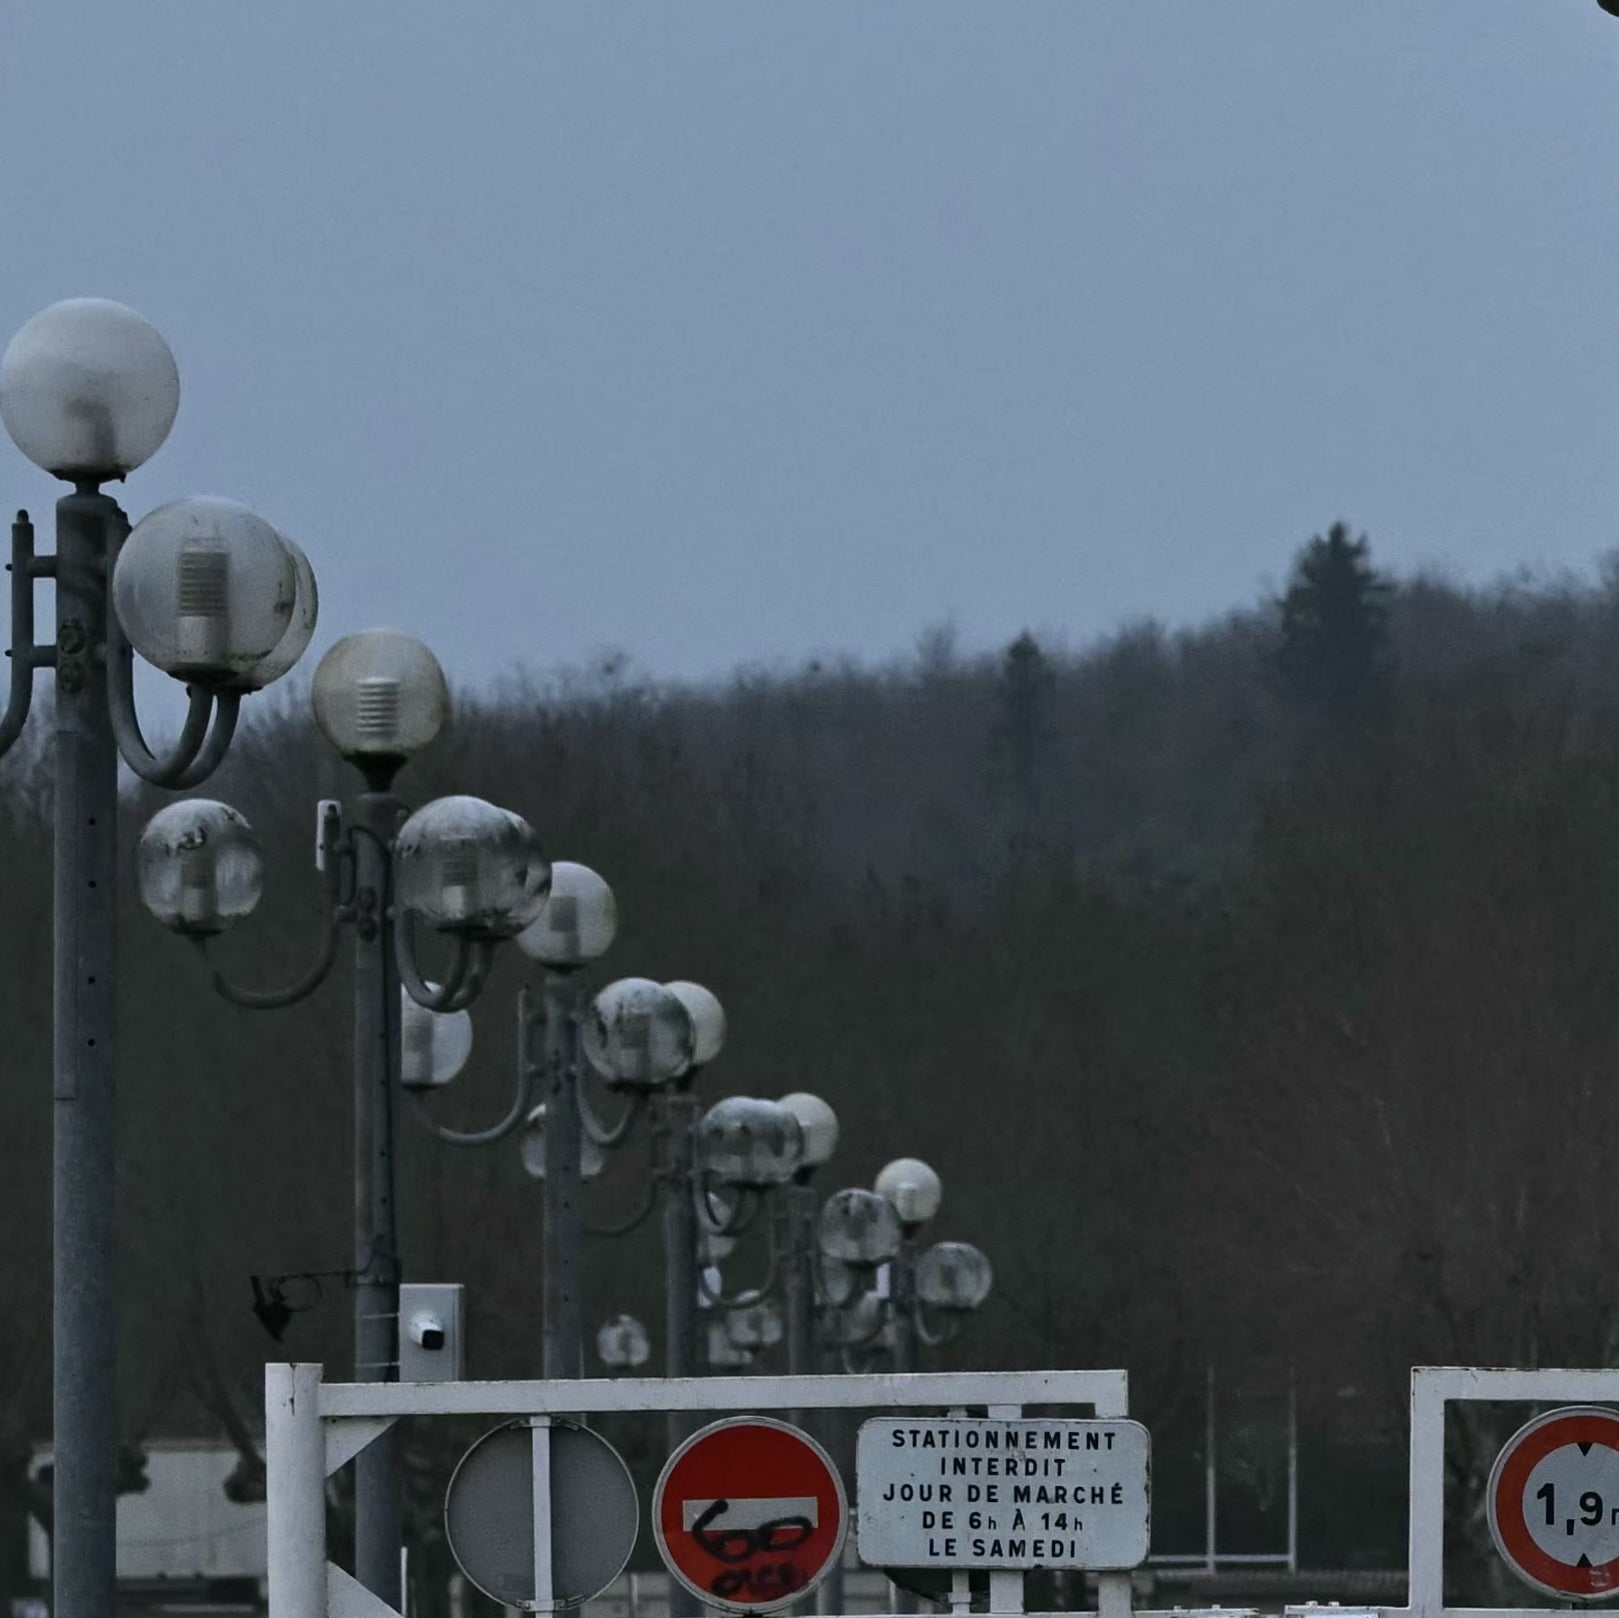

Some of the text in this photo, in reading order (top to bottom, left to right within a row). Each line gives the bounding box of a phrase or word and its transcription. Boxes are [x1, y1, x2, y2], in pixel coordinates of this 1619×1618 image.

[892, 1429, 1116, 1450] STATIONNEMENT
[941, 1457, 1066, 1477] INTERDIT
[883, 1482, 1123, 1505] JOUR DE MARCHÉ
[922, 1508, 1083, 1532] DE 6h À 14h
[929, 1538, 1076, 1558] LE SAMEDI
